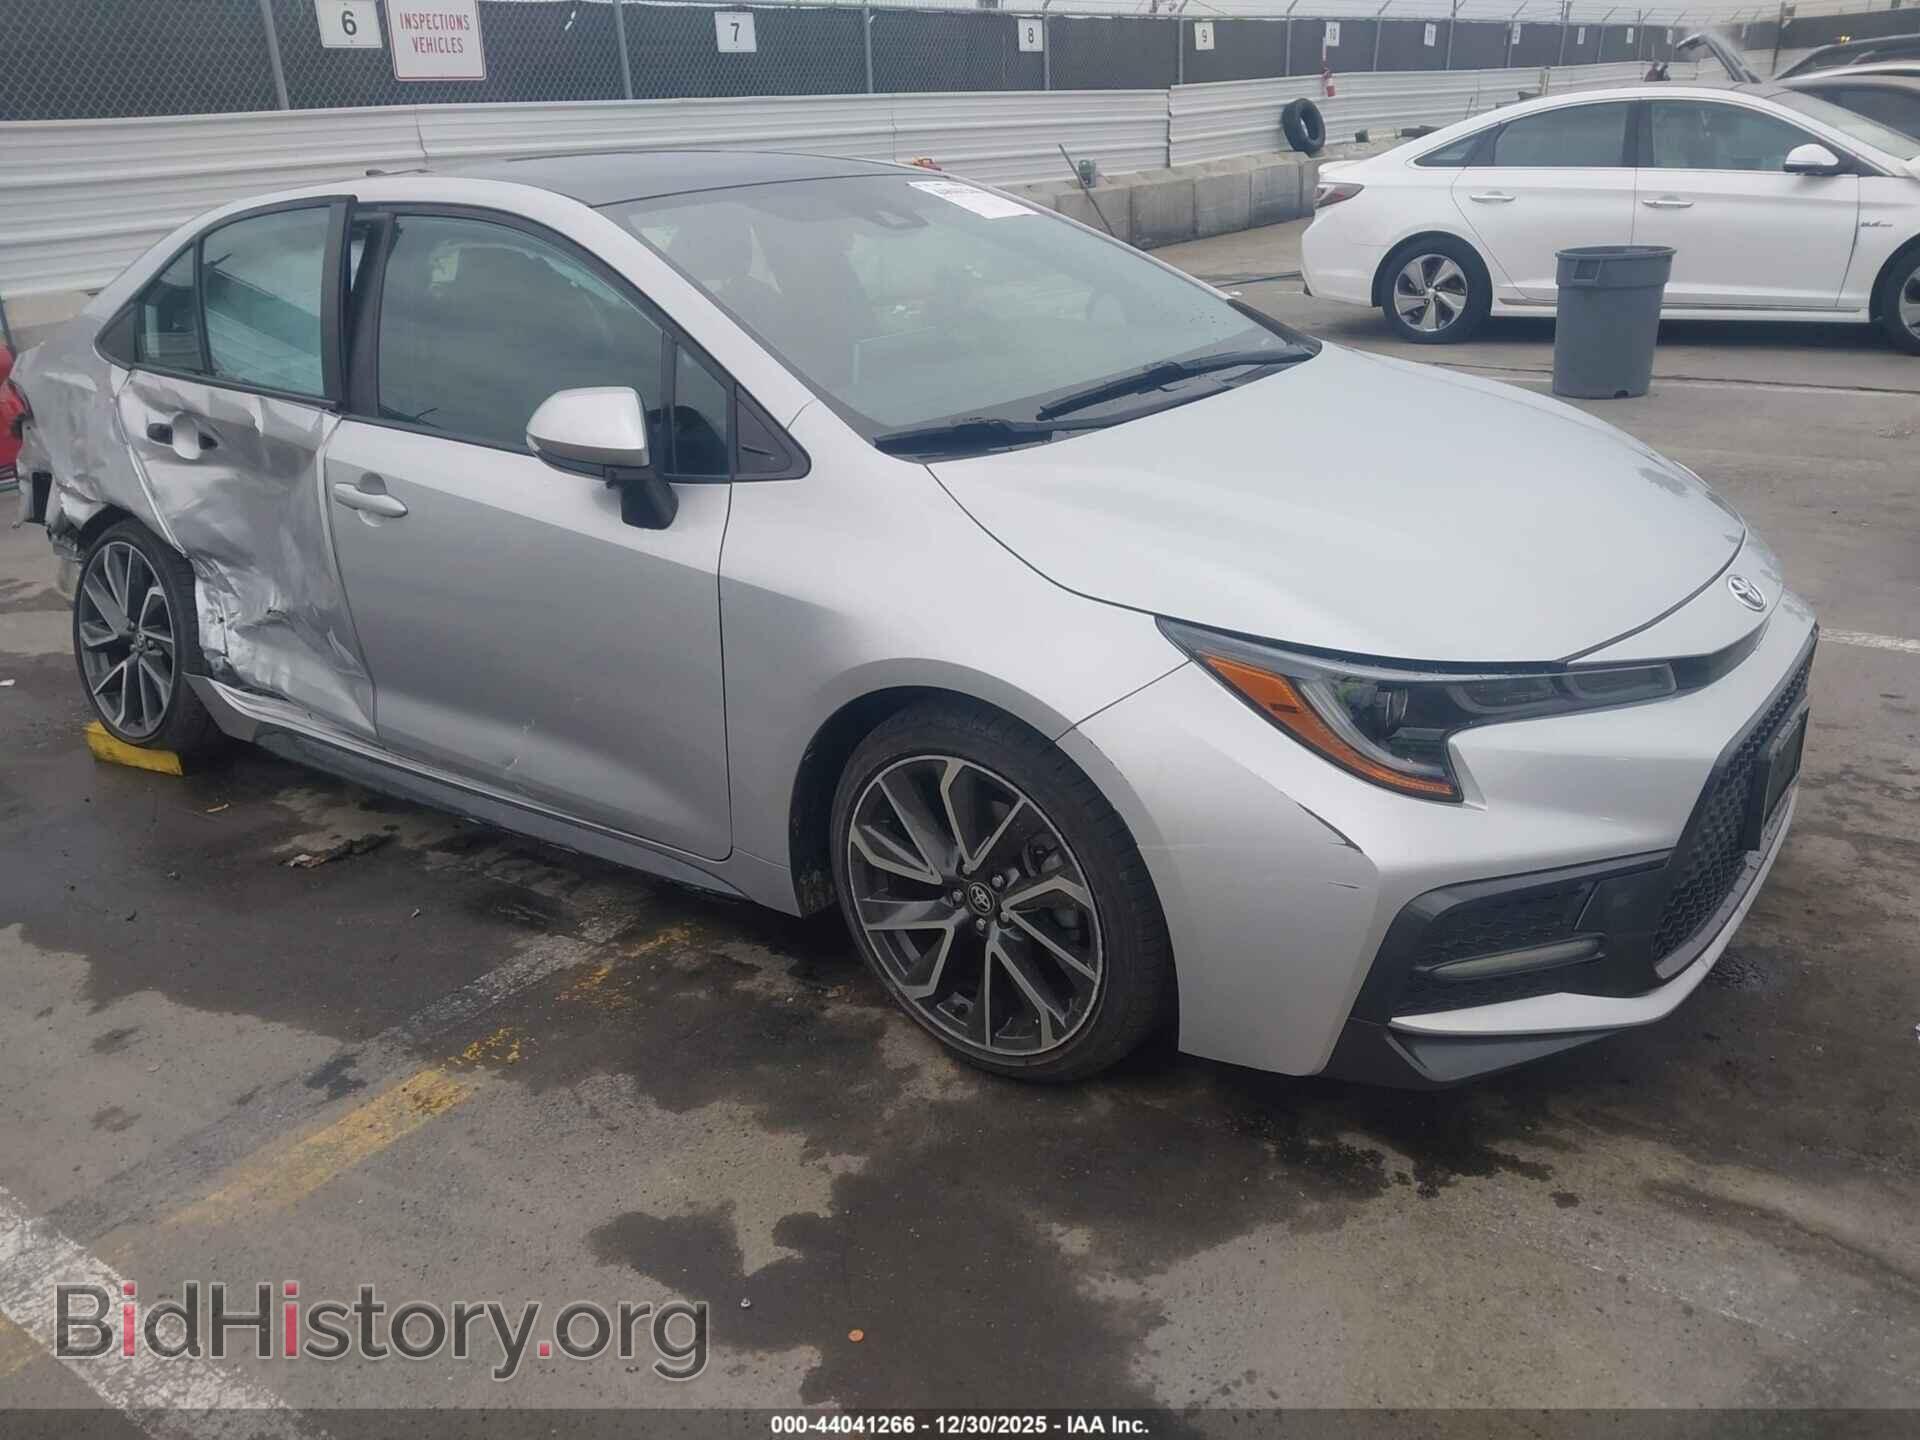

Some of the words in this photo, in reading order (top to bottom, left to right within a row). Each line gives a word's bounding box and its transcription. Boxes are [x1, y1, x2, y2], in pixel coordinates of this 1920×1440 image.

[341, 10, 358, 36] 6
[400, 12, 471, 31] INSPECTIONS
[730, 22, 740, 42] 7
[1027, 27, 1034, 44] 8
[1201, 29, 1208, 43] 9
[411, 36, 465, 54] VEHICLES
